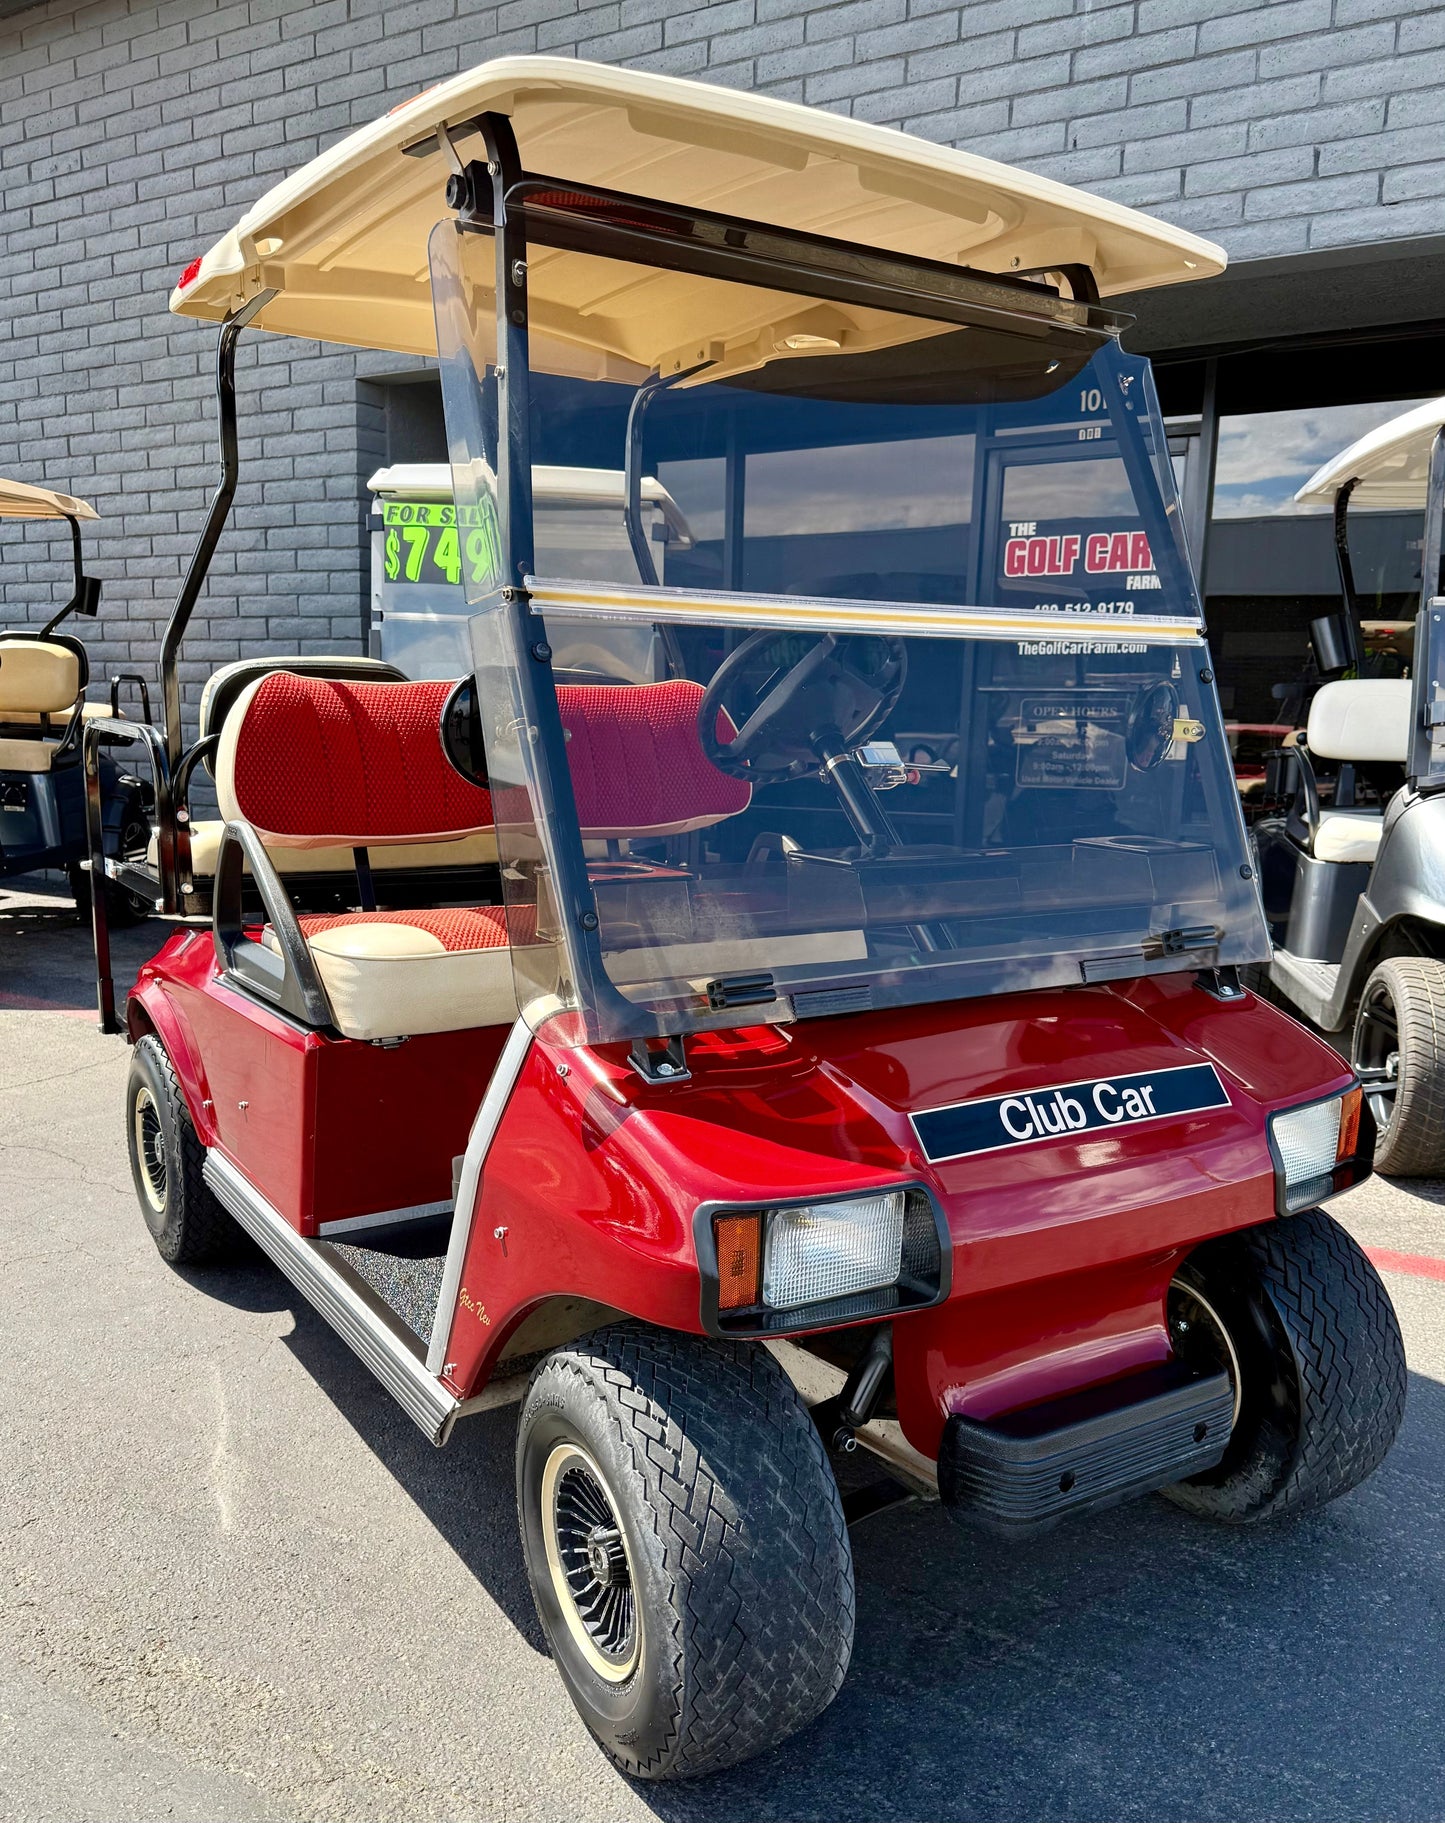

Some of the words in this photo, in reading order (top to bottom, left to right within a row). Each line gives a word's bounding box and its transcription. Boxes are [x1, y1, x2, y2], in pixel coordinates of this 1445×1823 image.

[386, 505, 431, 524] FOR
[1009, 522, 1037, 536] THE
[385, 527, 502, 585] $749
[1004, 535, 1081, 577] GOLF
[1085, 531, 1156, 573] CAR
[1126, 575, 1162, 590] FARM
[1034, 601, 1135, 614] 512-9179
[1018, 641, 1147, 655] TheGolfCartFarm.com
[1033, 706, 1067, 716] OPEN
[1071, 707, 1118, 717] HOURS
[1000, 1091, 1087, 1140] Club
[1092, 1083, 1157, 1122] Car
